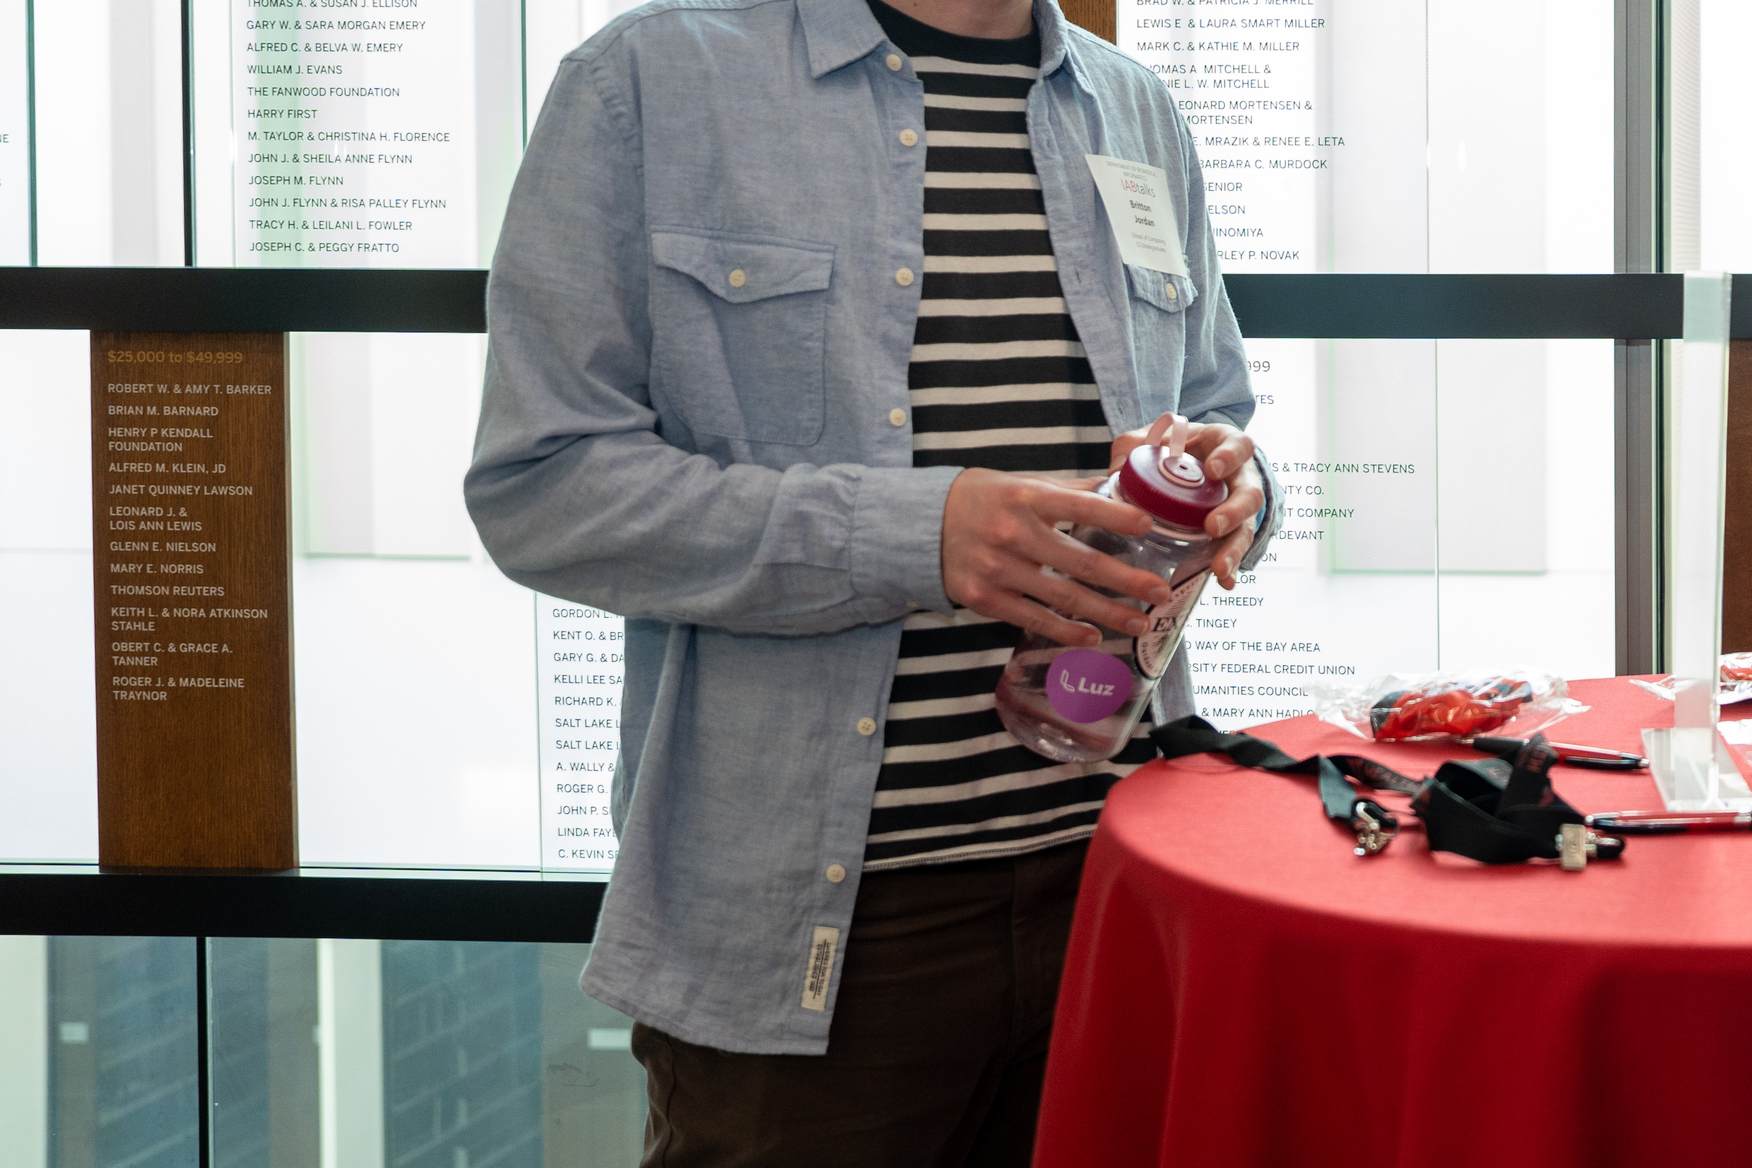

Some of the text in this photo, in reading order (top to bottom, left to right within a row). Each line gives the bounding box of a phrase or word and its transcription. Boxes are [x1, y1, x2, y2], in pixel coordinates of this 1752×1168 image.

[248, 87, 400, 96] THE FANWOOD FOUNDATION
[248, 109, 317, 118] HARRY FIRST
[1121, 179, 1156, 197] IABtalks
[1129, 199, 1152, 212] Britton
[1134, 214, 1156, 227] Jordan
[108, 351, 243, 363] $25,000 to $49,999
[108, 406, 219, 416] BRIAN M. BARNARD
[109, 428, 213, 438] HENRY P KENDALL
[109, 442, 182, 451] FOUNDATION
[109, 485, 253, 496] JANET QUINNEY LAWSON
[110, 541, 216, 552] GLENN E. NIELSON
[110, 564, 204, 574] MARY E. NORRIS
[111, 585, 225, 596] THOMSON REUTERS
[1212, 597, 1264, 606] THREEDY
[1196, 619, 1237, 628] TINGEY
[1196, 641, 1218, 650] WAY
[1222, 641, 1236, 650] OF
[1241, 642, 1262, 651] THE
[1266, 642, 1286, 651] BAY
[1291, 643, 1321, 652] AREA
[1221, 664, 1355, 675] FEDERAL CREDIT UNION
[1078, 677, 1115, 696] Luz
[113, 690, 167, 700] TRAYNOR
[555, 718, 581, 727] SALT
[585, 719, 612, 728] LAKE
